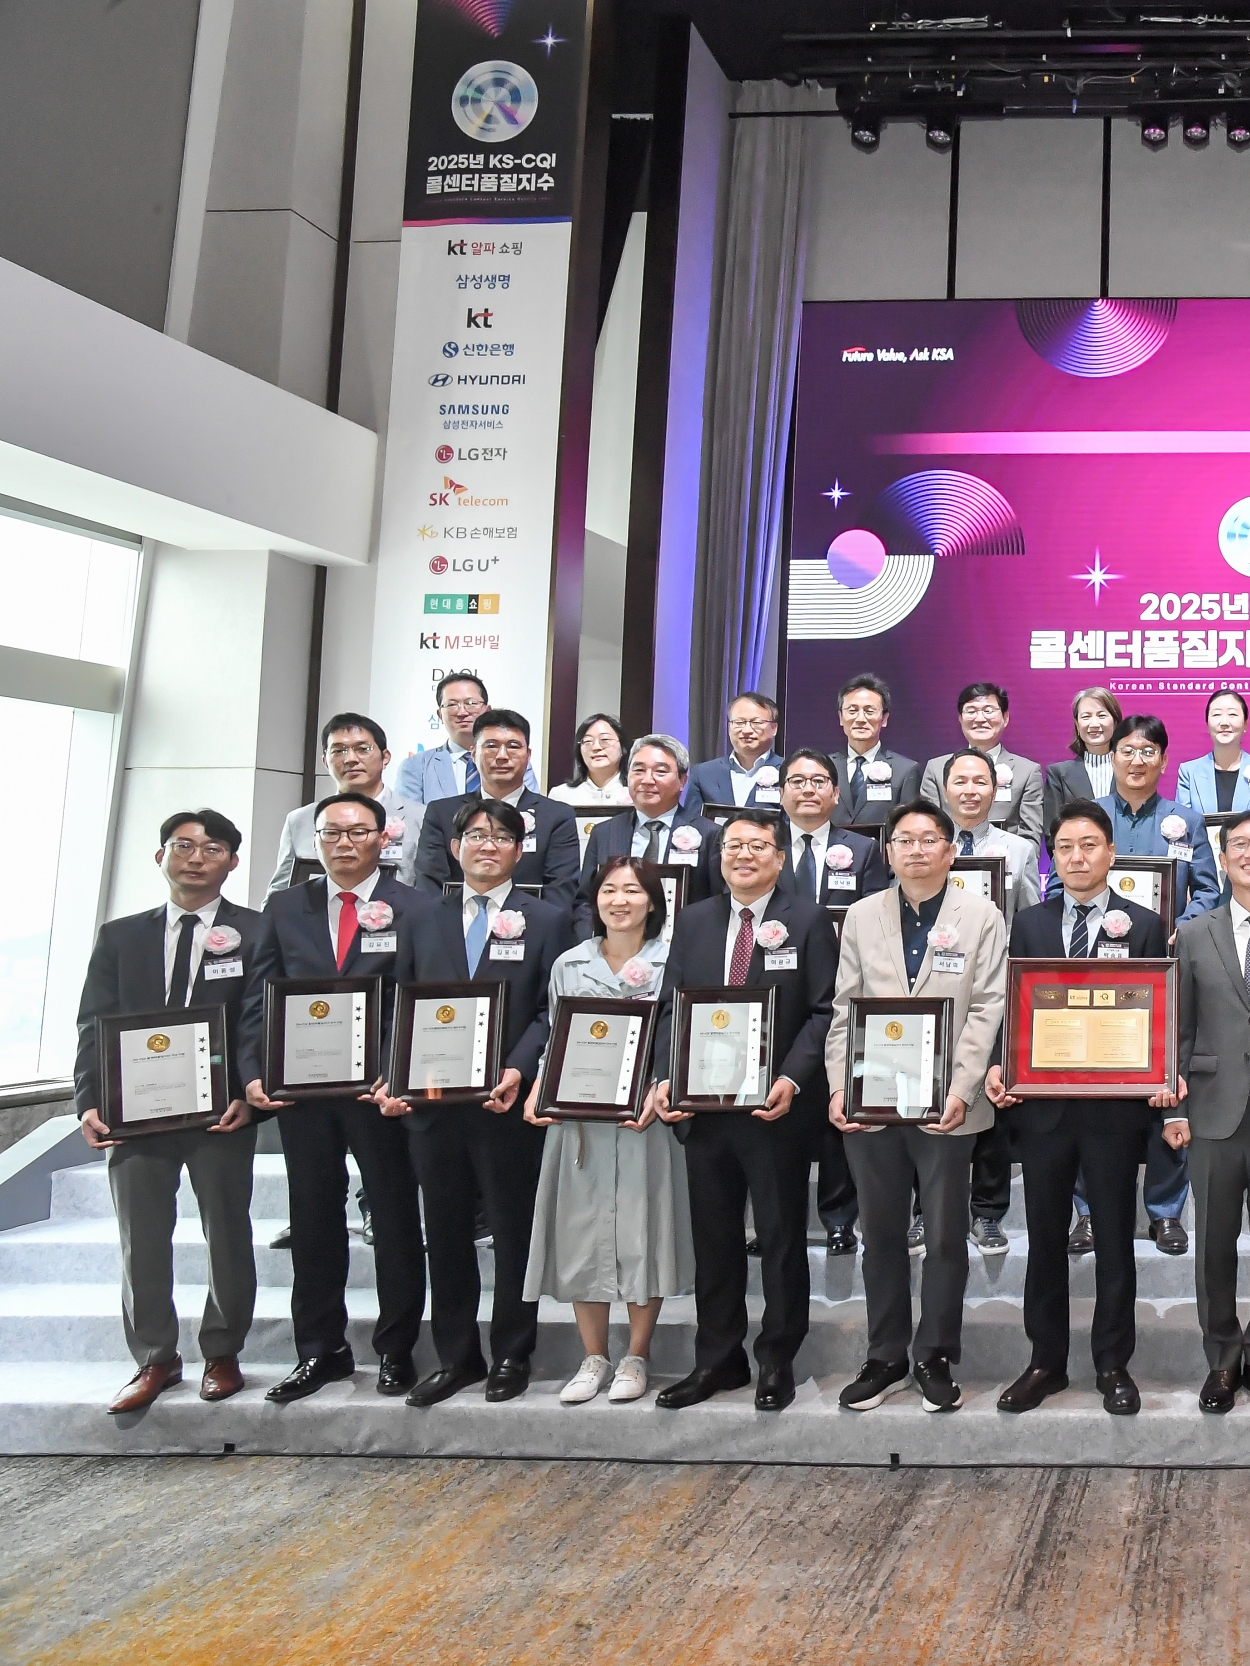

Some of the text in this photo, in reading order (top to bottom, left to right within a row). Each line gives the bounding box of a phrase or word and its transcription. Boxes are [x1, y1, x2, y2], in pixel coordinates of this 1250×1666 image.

[427, 153, 556, 171] 2025년 KS-CQI
[426, 173, 555, 194] 콜센터품질지수
[447, 239, 523, 256] kt 알파 쇼핑
[455, 274, 511, 289] 삼성생명
[466, 308, 494, 328] kt
[462, 342, 515, 357] 신한은행
[877, 348, 907, 363] Value,
[909, 347, 930, 361] Ask
[931, 348, 954, 361] KSA
[457, 374, 526, 386] HYUNDAI
[439, 404, 510, 416] SAMSUNG
[443, 420, 504, 430] 삼성전자서비스
[429, 493, 508, 506] SK telecom
[429, 598, 492, 610] 현대홈쇼핑
[1139, 592, 1250, 621] 2025년
[420, 632, 441, 650] kt
[1109, 682, 1153, 691] Korean
[1158, 682, 1215, 691] Standard
